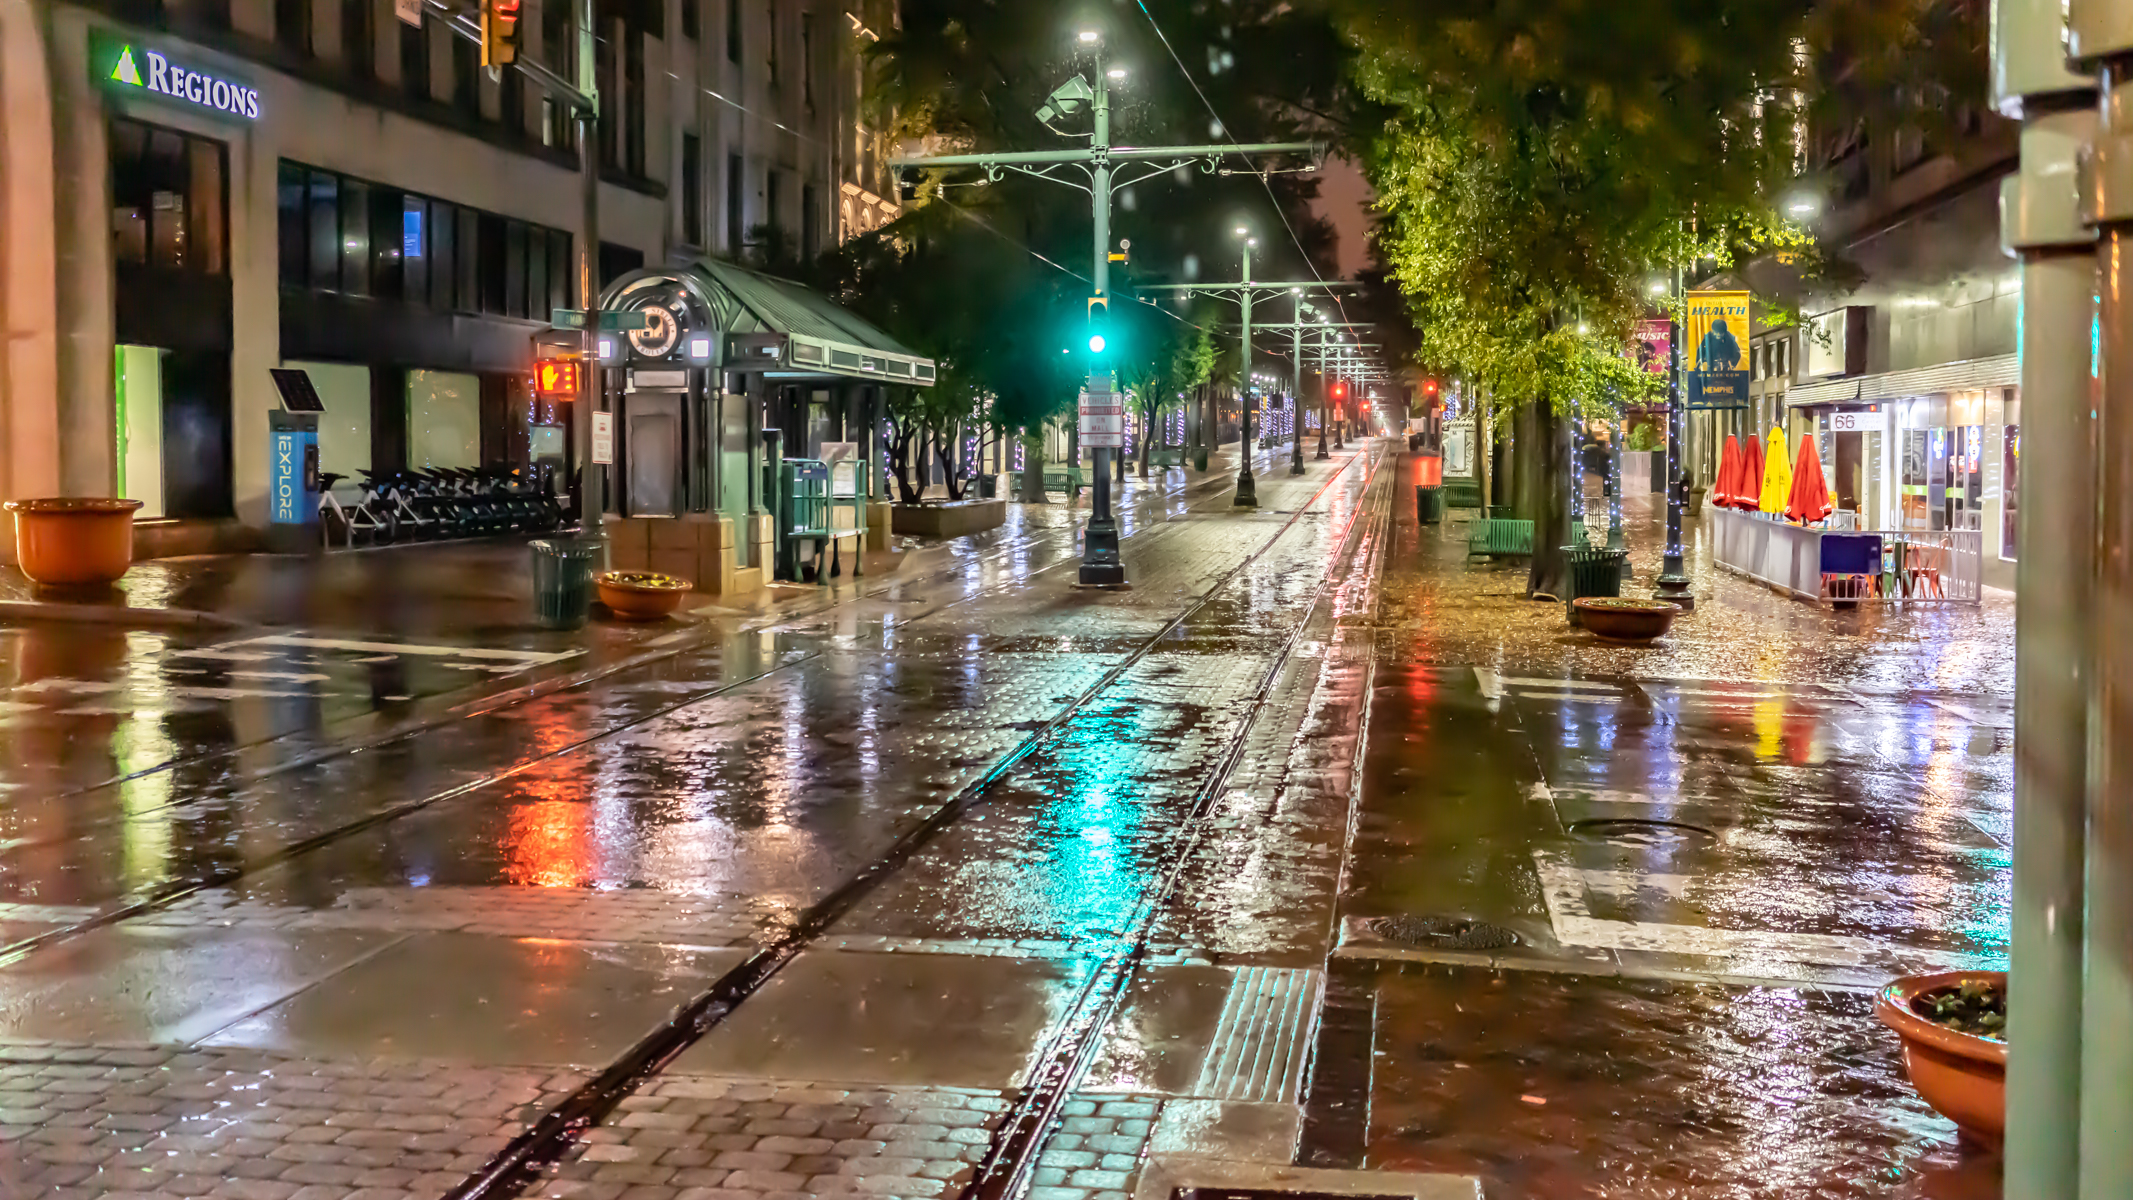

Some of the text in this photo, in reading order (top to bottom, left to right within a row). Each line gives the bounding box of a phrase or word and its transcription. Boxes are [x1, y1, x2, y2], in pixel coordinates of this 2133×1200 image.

[147, 50, 258, 118] REGIONS
[1691, 306, 1747, 315] HEALTH
[1631, 332, 1669, 341] MUSIC
[1703, 386, 1734, 395] MEMPHIS
[1082, 397, 1119, 405] VEHICLES
[1834, 415, 1855, 430] 66
[279, 441, 292, 520] EXPLORE
